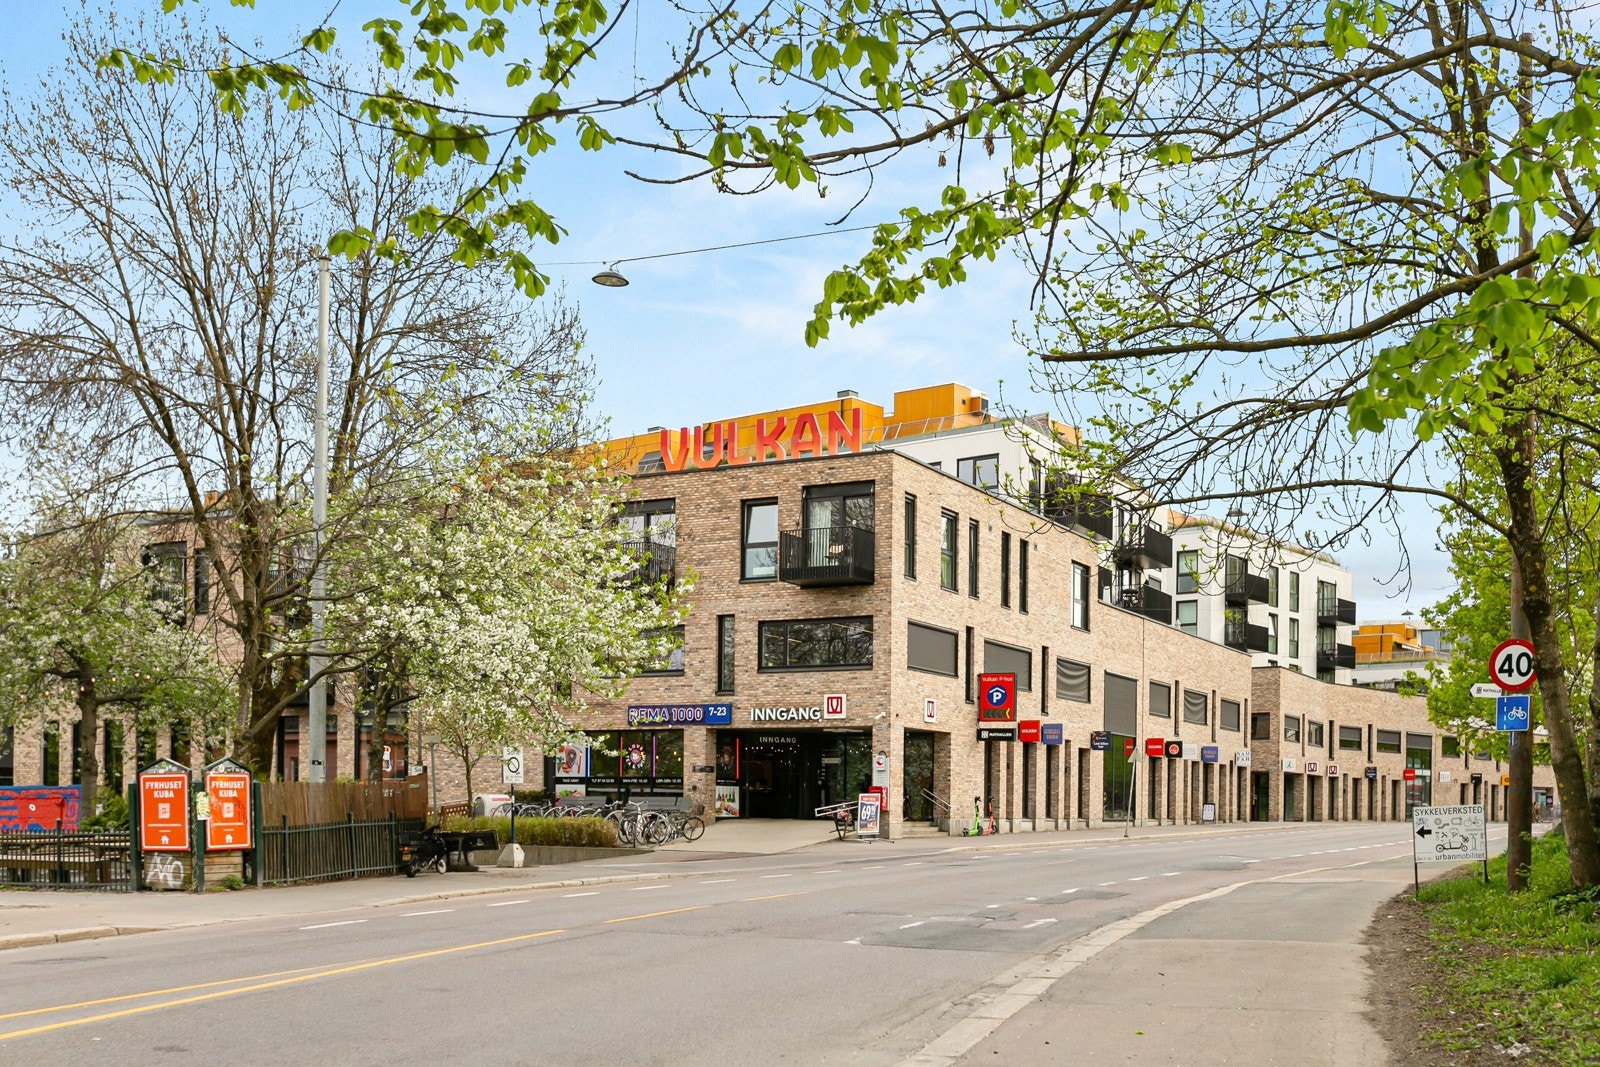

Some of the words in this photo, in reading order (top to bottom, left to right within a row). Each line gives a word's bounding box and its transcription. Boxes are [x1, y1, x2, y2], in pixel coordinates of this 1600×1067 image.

[660, 407, 863, 472] VULKAN
[1498, 652, 1532, 677] 40
[629, 708, 669, 721] REMA
[672, 707, 703, 721] 1000
[708, 706, 727, 716] 7-23
[750, 706, 821, 721] INNGANG
[759, 736, 797, 744] INNGANG
[146, 781, 182, 789] FYRHUSET
[211, 781, 244, 789] FYRHUSET
[153, 790, 174, 798] KUBA
[219, 790, 238, 798] KUBA
[1414, 806, 1483, 816] SYKKELVERKSTED
[1435, 852, 1485, 861] urbanmobilitet
